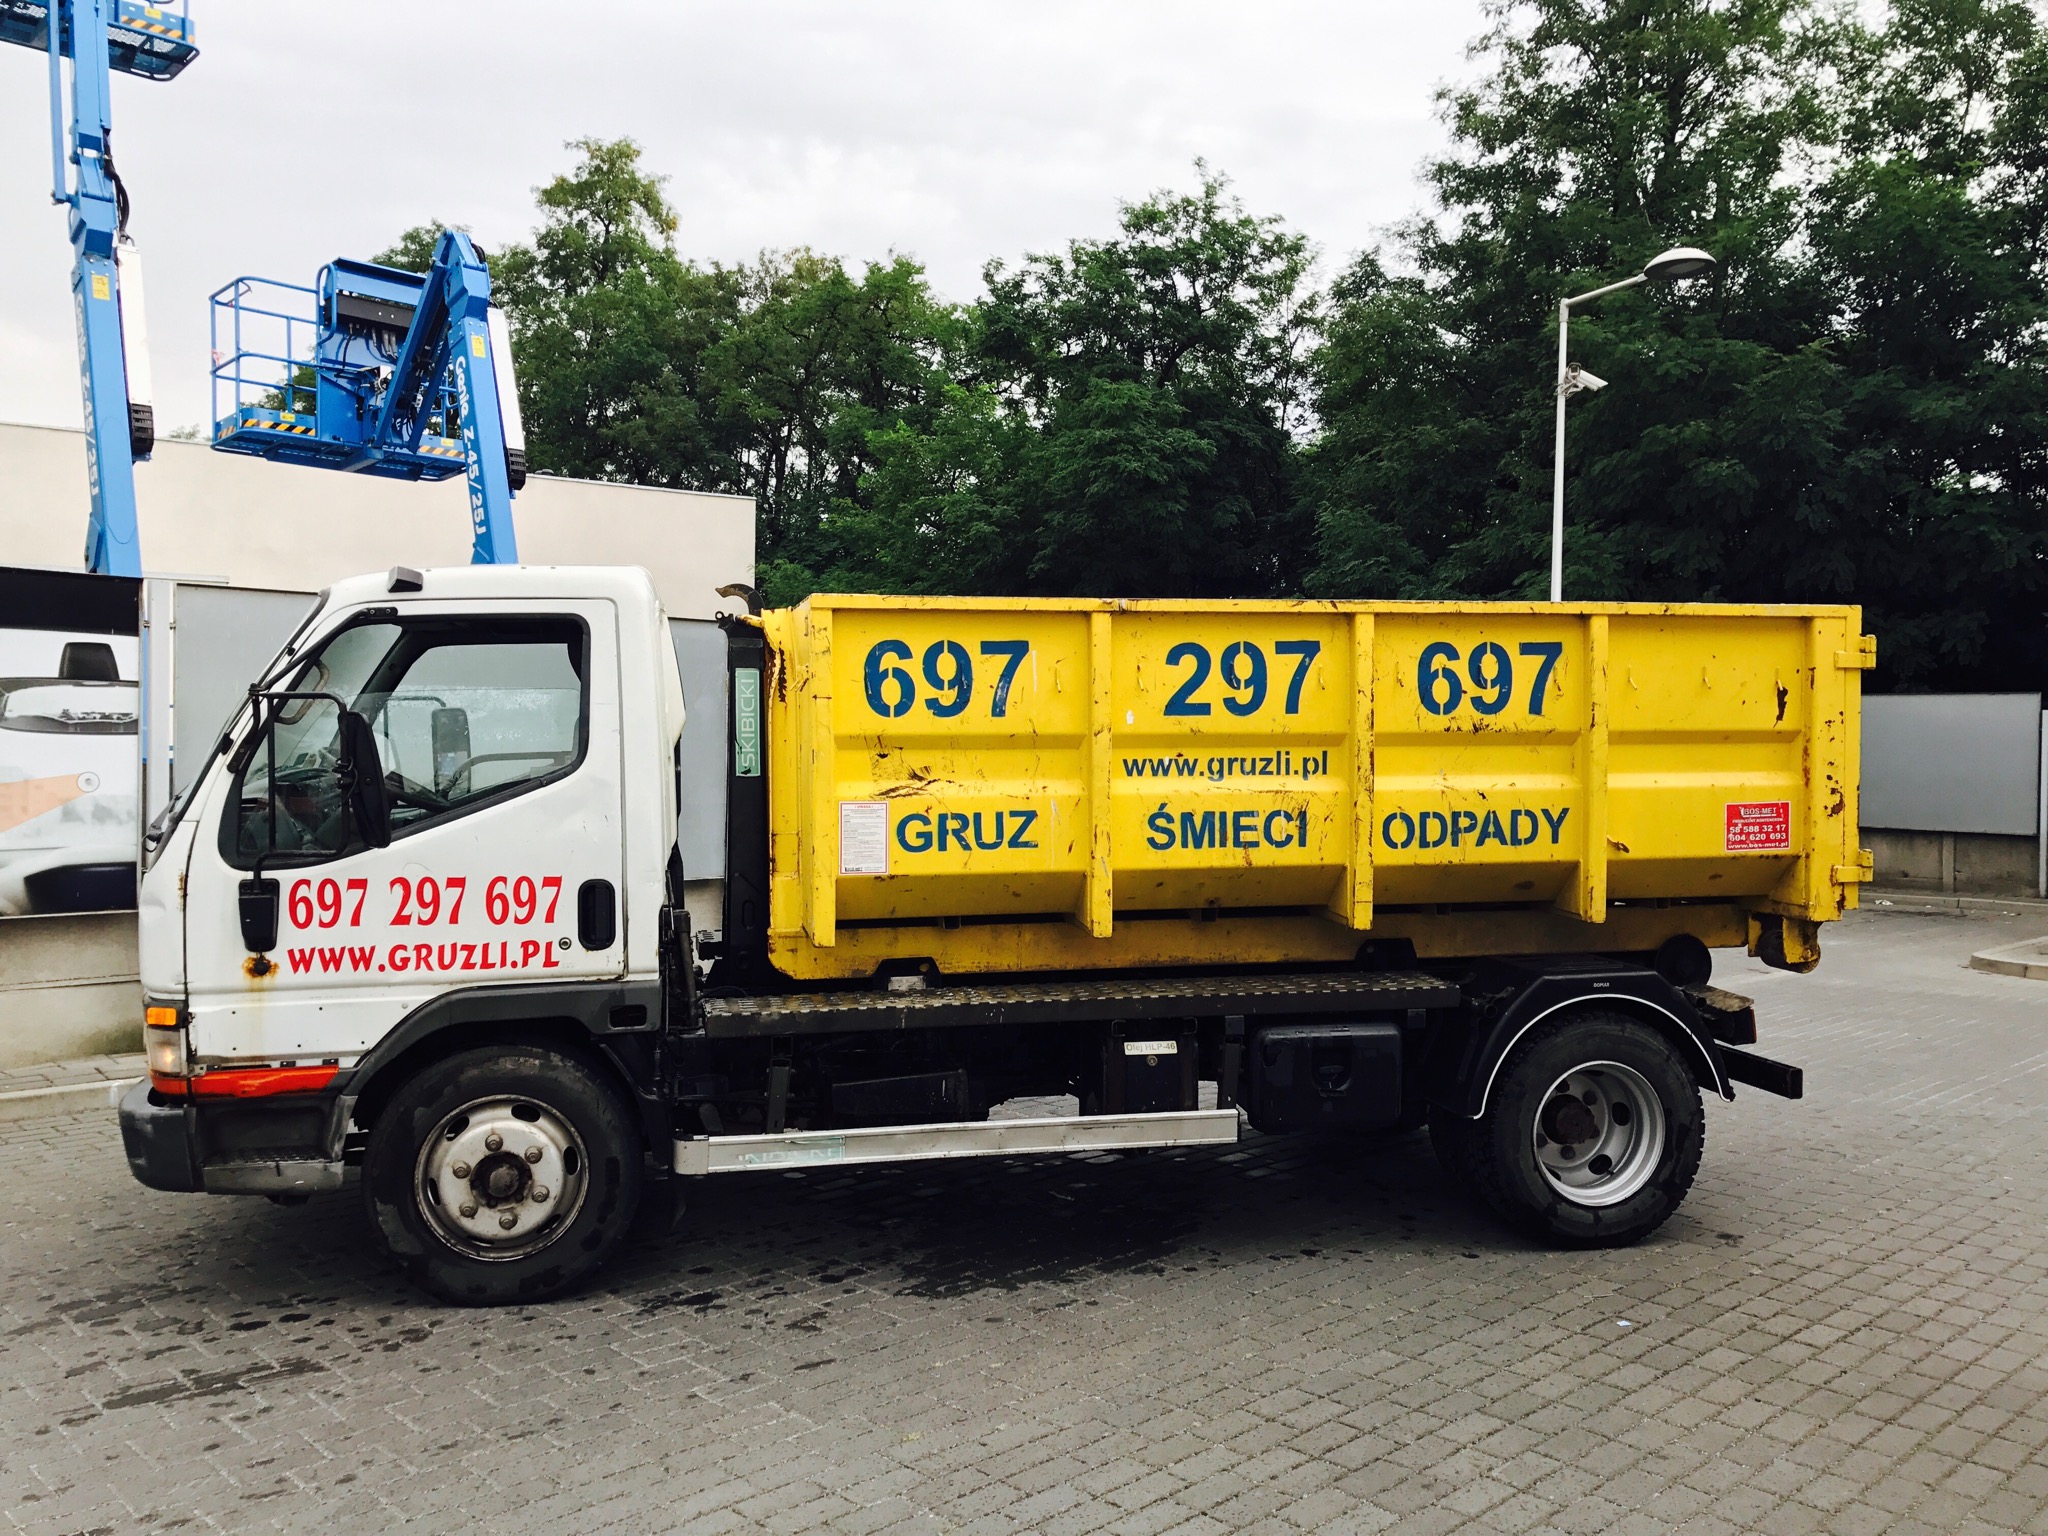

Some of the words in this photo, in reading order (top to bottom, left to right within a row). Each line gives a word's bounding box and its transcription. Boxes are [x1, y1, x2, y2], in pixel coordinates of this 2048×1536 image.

[75, 293, 87, 364] Genie
[81, 371, 100, 496] Z-45/25J
[455, 355, 469, 420] Genie
[463, 425, 487, 535] Z-45/25J
[864, 639, 1030, 718] 697
[1163, 639, 1322, 717] 297
[1417, 641, 1563, 716] 697
[741, 679, 755, 767] SKIBICKI
[1122, 750, 1328, 782] www.gruzli.pl
[896, 809, 1039, 853] GRUZ
[1146, 803, 1308, 851] ŚMIECI
[1382, 807, 1570, 850] ODPADY
[1744, 807, 1777, 815] BOS-MET
[1728, 841, 1788, 849] www.bos-met.pl
[1743, 825, 1760, 833] 588
[1762, 824, 1773, 832] 32
[1749, 833, 1767, 841] 620
[1769, 832, 1786, 840] 693
[288, 877, 368, 930] 697
[389, 876, 466, 926] 297
[485, 876, 562, 926] 697
[287, 940, 560, 974] WWW.GRUZLI.PL
[1126, 1043, 1143, 1052] Olej
[1145, 1042, 1176, 1051] HLP-46
